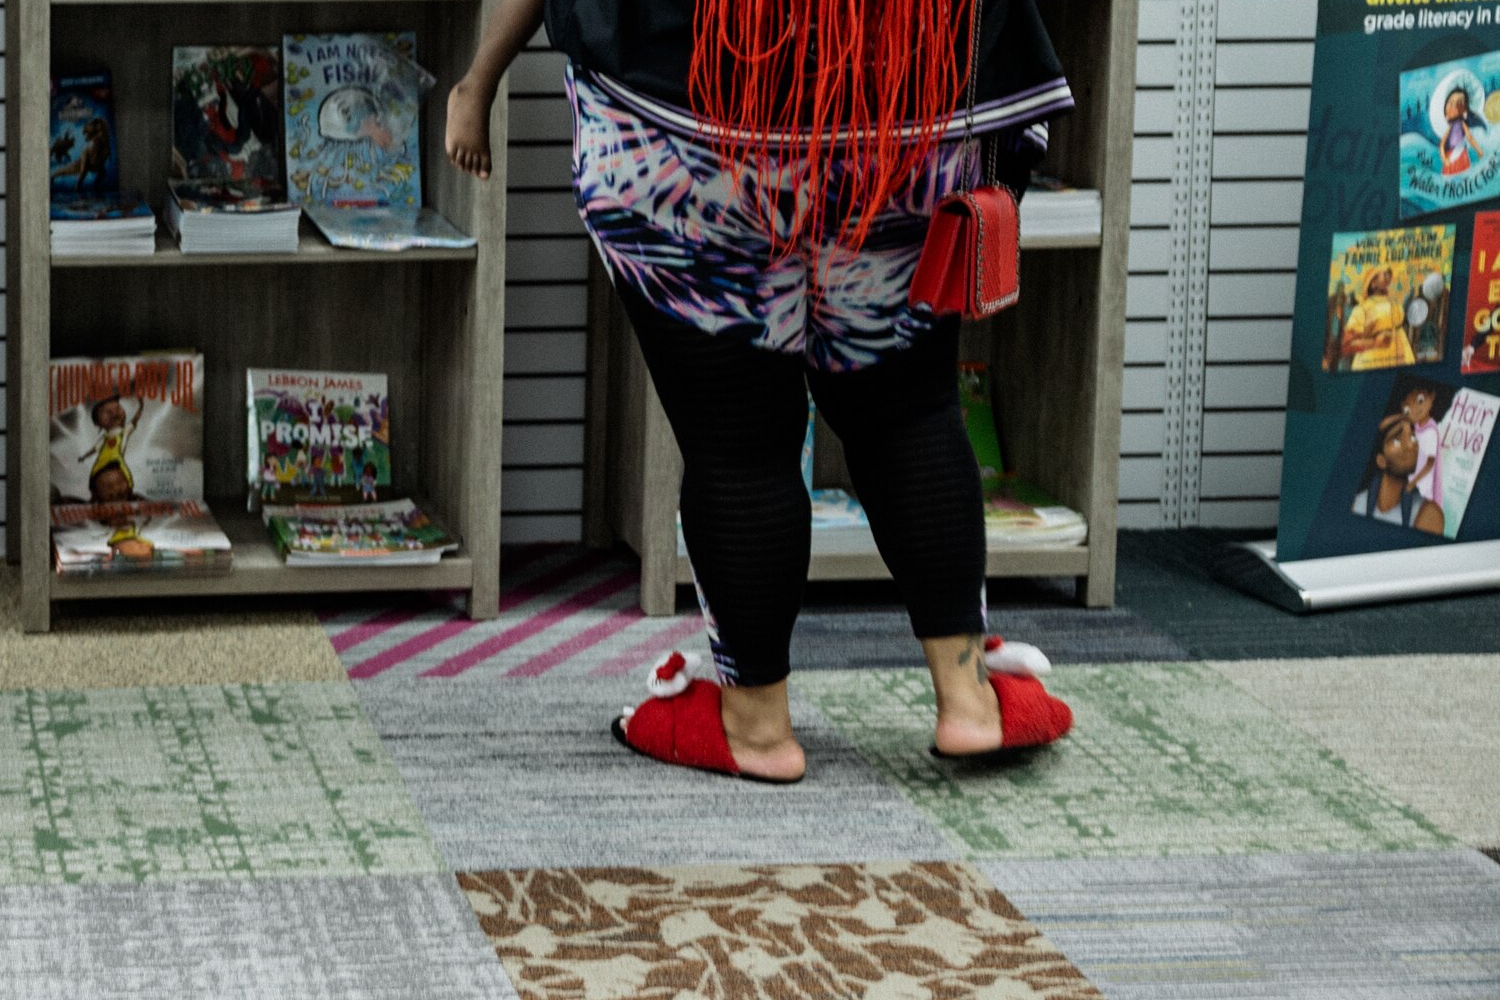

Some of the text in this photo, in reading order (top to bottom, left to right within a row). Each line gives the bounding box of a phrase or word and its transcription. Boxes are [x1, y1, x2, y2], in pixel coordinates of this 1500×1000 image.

[1363, 9, 1415, 35] grade
[1418, 6, 1475, 31] literacy
[1477, 4, 1492, 25] in
[323, 376, 364, 391] JAMES
[1451, 392, 1494, 427] Hair
[261, 420, 372, 450] PROMISE
[1441, 422, 1485, 455] Love
